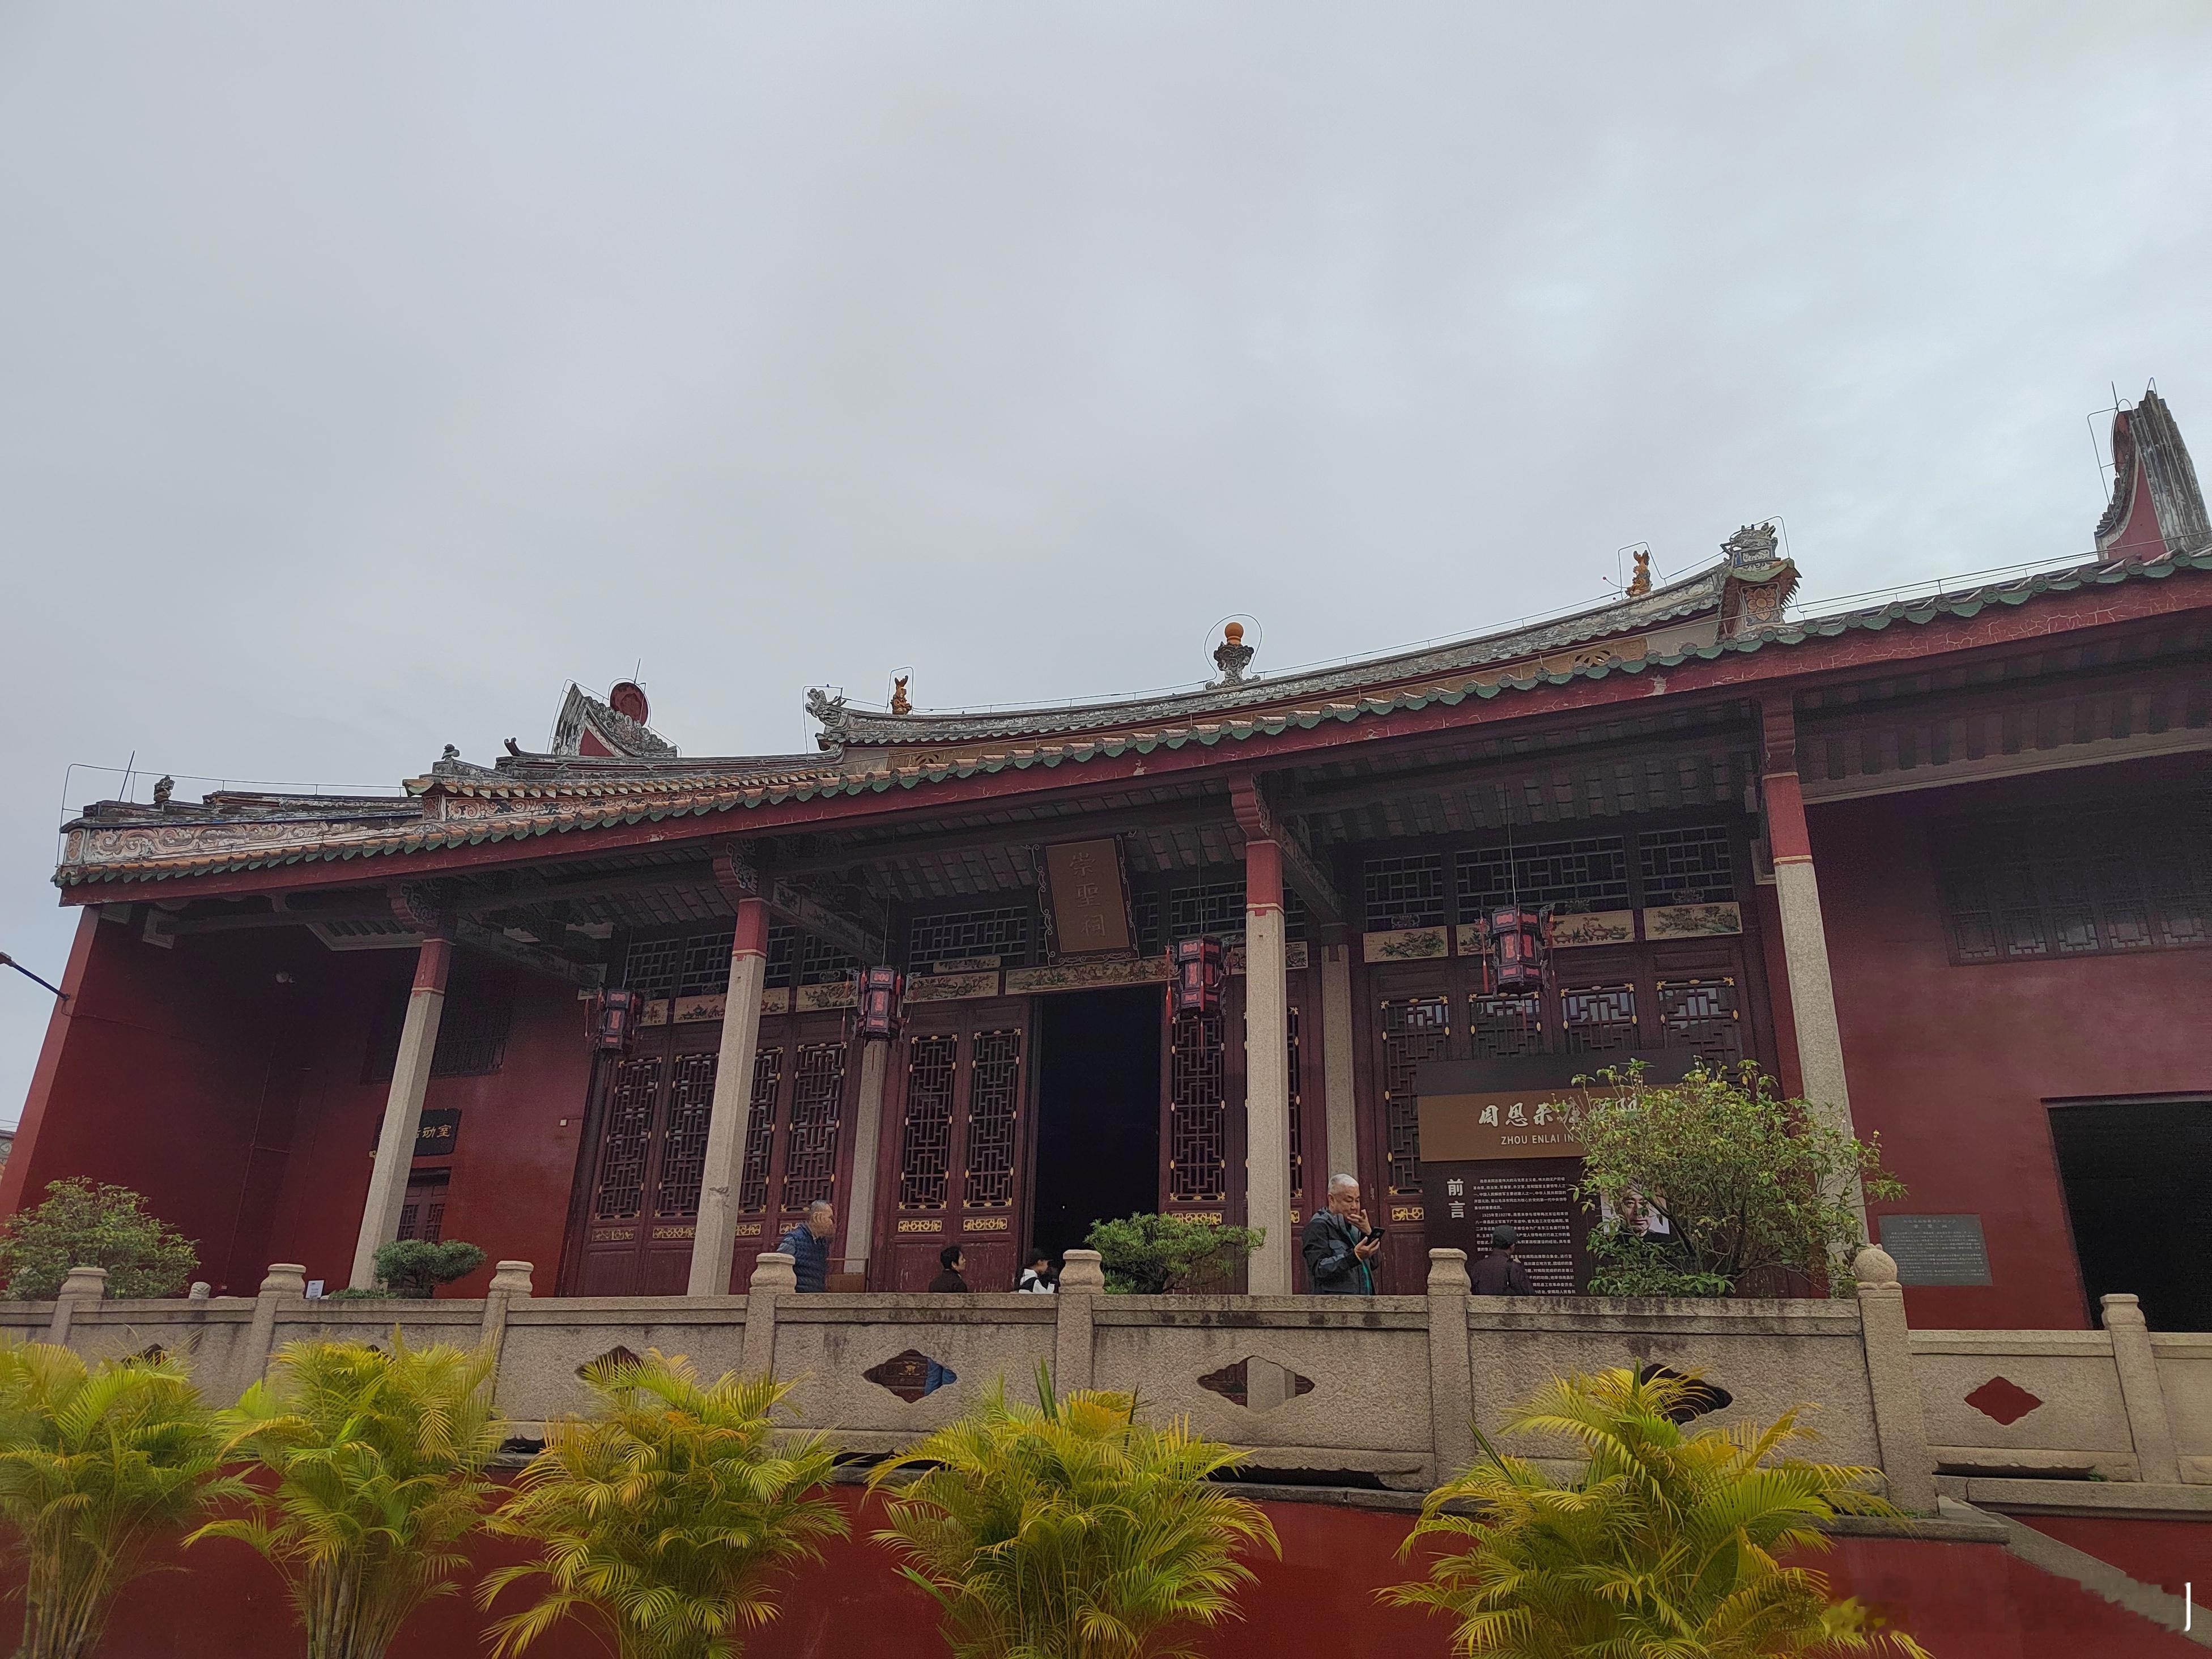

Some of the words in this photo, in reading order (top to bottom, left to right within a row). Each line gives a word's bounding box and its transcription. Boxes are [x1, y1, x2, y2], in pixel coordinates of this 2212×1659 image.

[1069, 852, 1106, 938] 崇聖祠
[1501, 1134, 1528, 1145] ZHOU
[1532, 1133, 1560, 1144] ENLAI
[1564, 1133, 1574, 1142] IN
[1447, 1179, 1465, 1218] 前言
